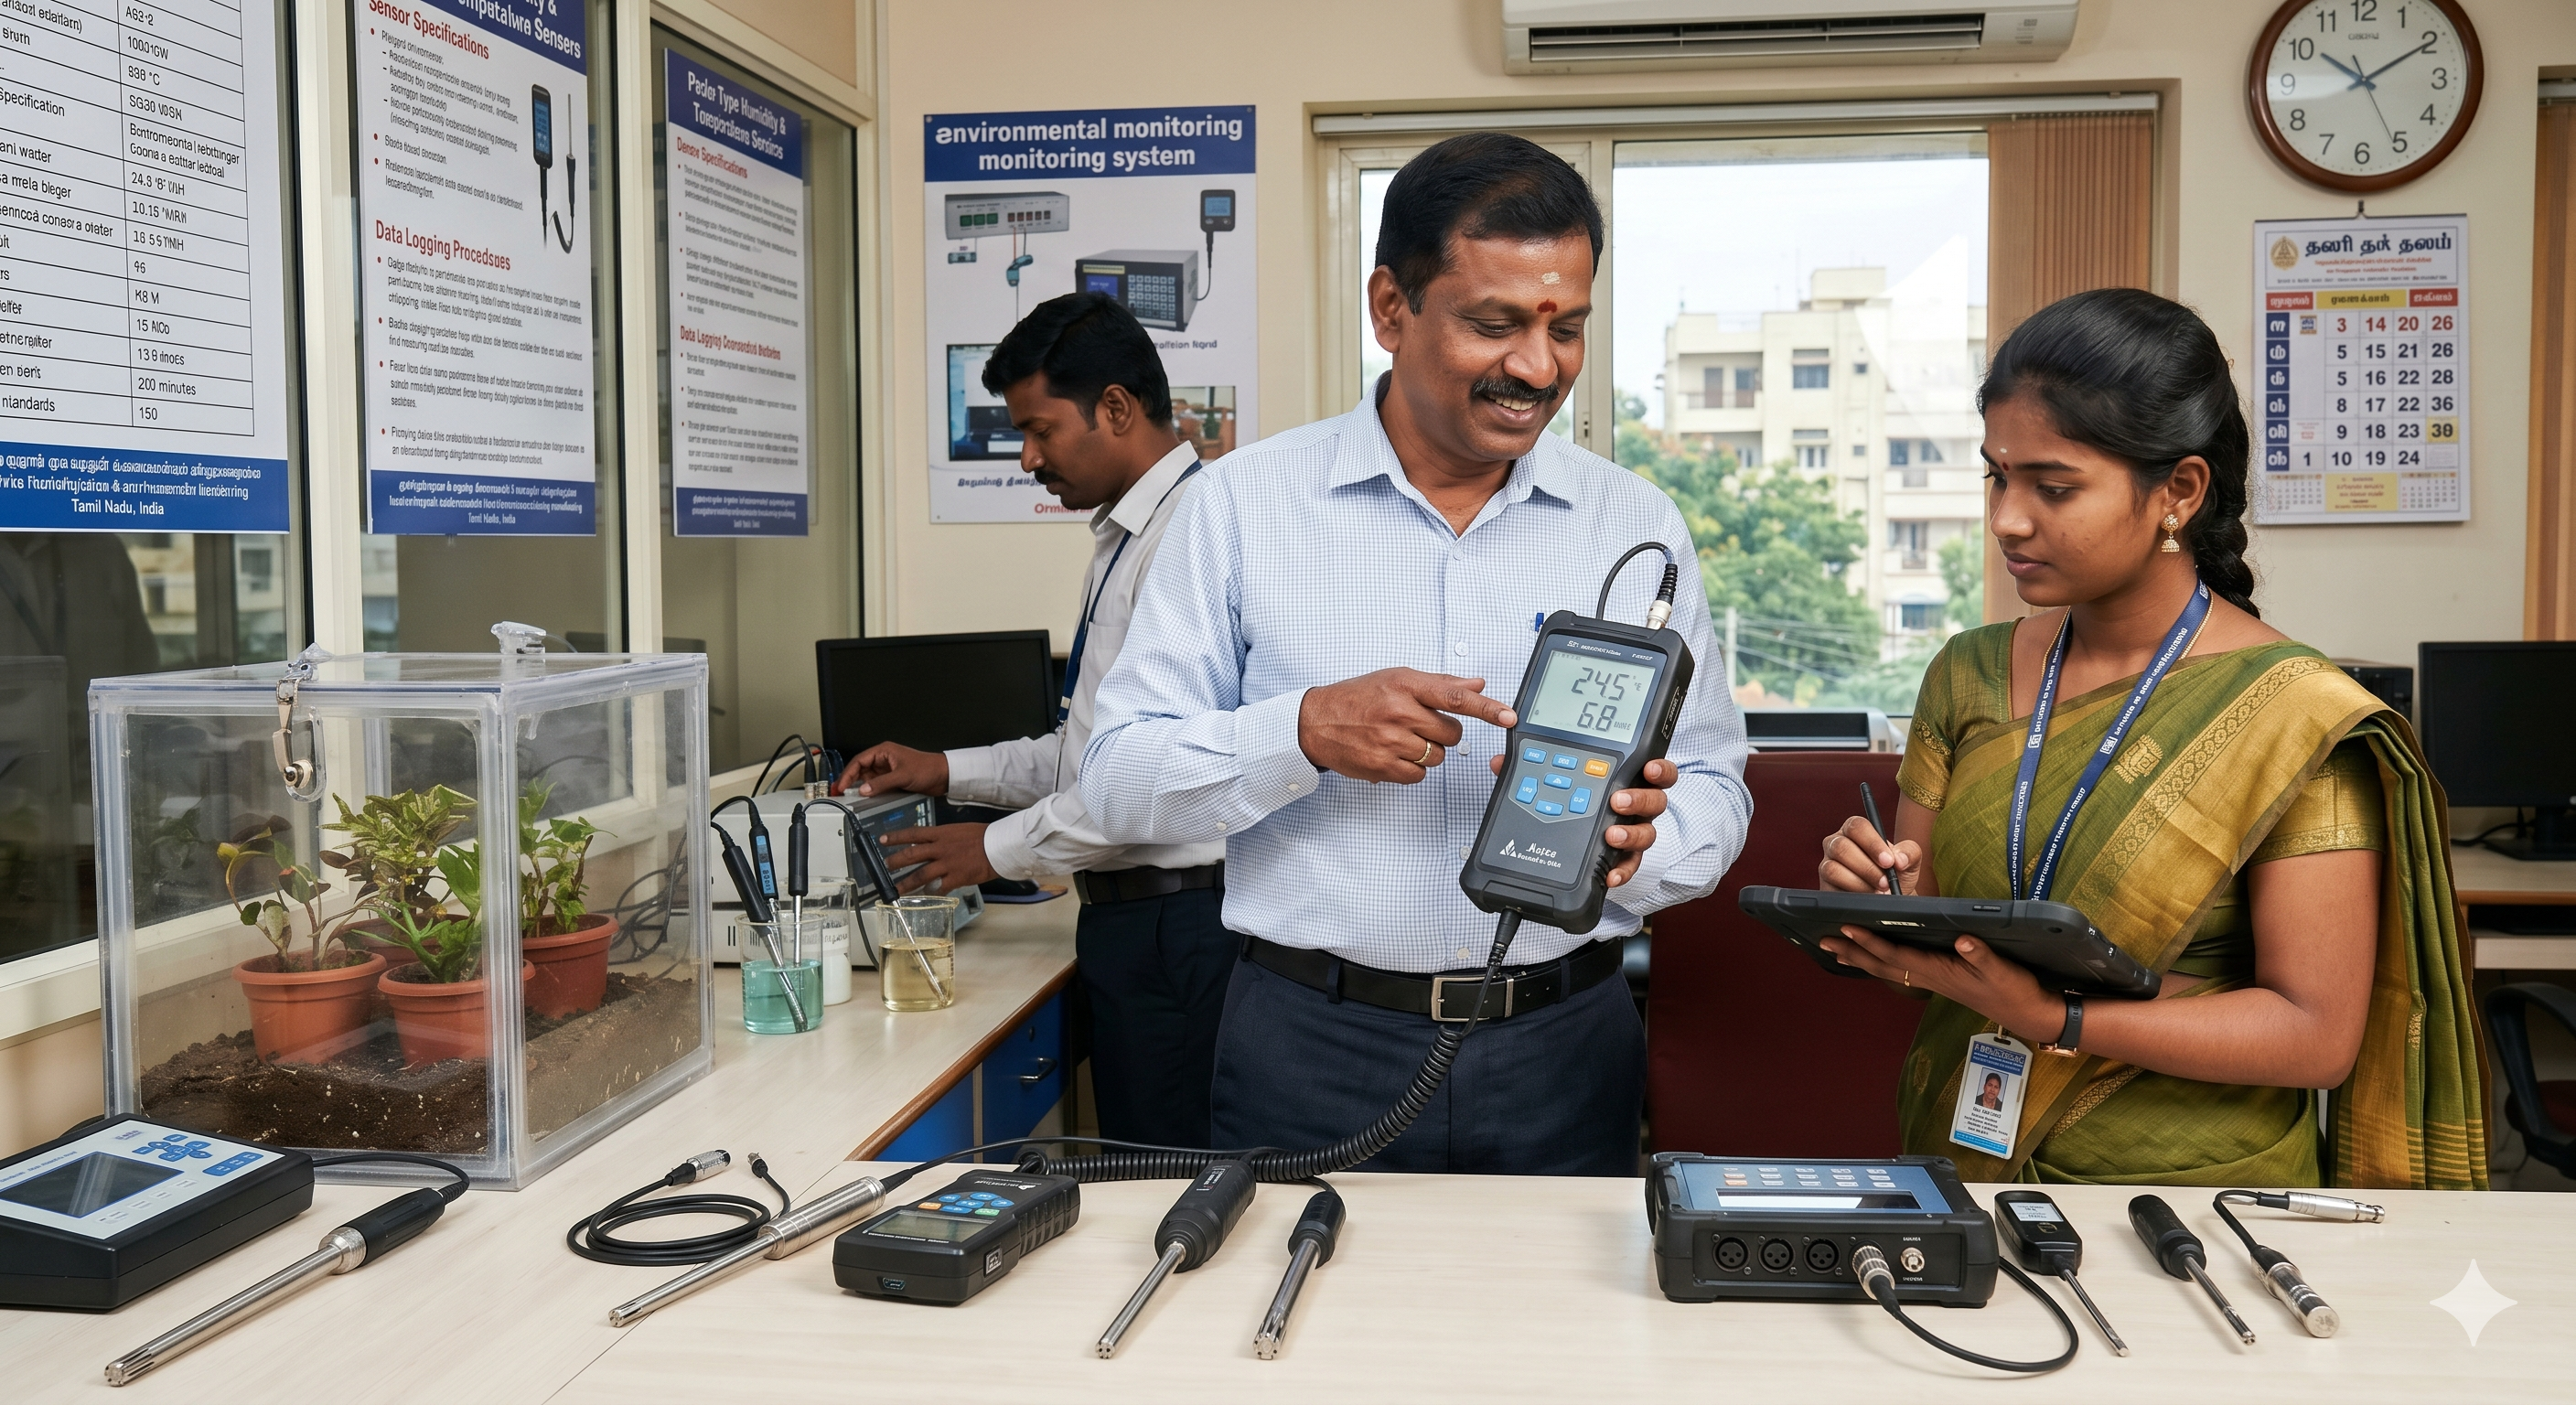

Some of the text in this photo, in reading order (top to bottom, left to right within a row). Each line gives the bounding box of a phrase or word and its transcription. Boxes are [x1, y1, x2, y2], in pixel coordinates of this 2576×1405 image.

[2316, 10, 2336, 33] 11
[2351, 0, 2377, 22] 12
[2397, 5, 2406, 28] 1
[370, 0, 489, 59] Sensor Specifications
[534, 17, 581, 59] Sensers
[2289, 38, 2314, 60] 10
[2420, 31, 2437, 54] 2
[2281, 73, 2296, 96] 9
[2431, 68, 2448, 90] 3
[717, 85, 739, 114] Type
[779, 116, 787, 135] &
[2290, 109, 2305, 132] 8
[2420, 103, 2436, 125] 4
[1113, 114, 1243, 141] monitoring
[2319, 134, 2334, 156] 7
[2392, 131, 2408, 154] 5
[979, 146, 1197, 173] monitoring system
[2355, 143, 2369, 165] 6
[376, 220, 402, 244] Data
[406, 227, 450, 260] Logging
[137, 319, 148, 331] 15
[2336, 316, 2453, 333] 3 14 20 26
[2336, 343, 2453, 360] 5 15 21 26
[138, 377, 196, 395] 200 minutes
[2336, 370, 2453, 386] 5 16 22 28
[139, 407, 157, 421] 150
[2336, 397, 2453, 413] 8 17 22 36
[2336, 426, 2347, 440] 9
[2366, 424, 2386, 439] 18
[2398, 424, 2420, 438] 23
[2303, 450, 2420, 467] 1 10 19 24
[71, 498, 165, 516] Tamil Nadu, India
[1572, 667, 1630, 701] 24.5
